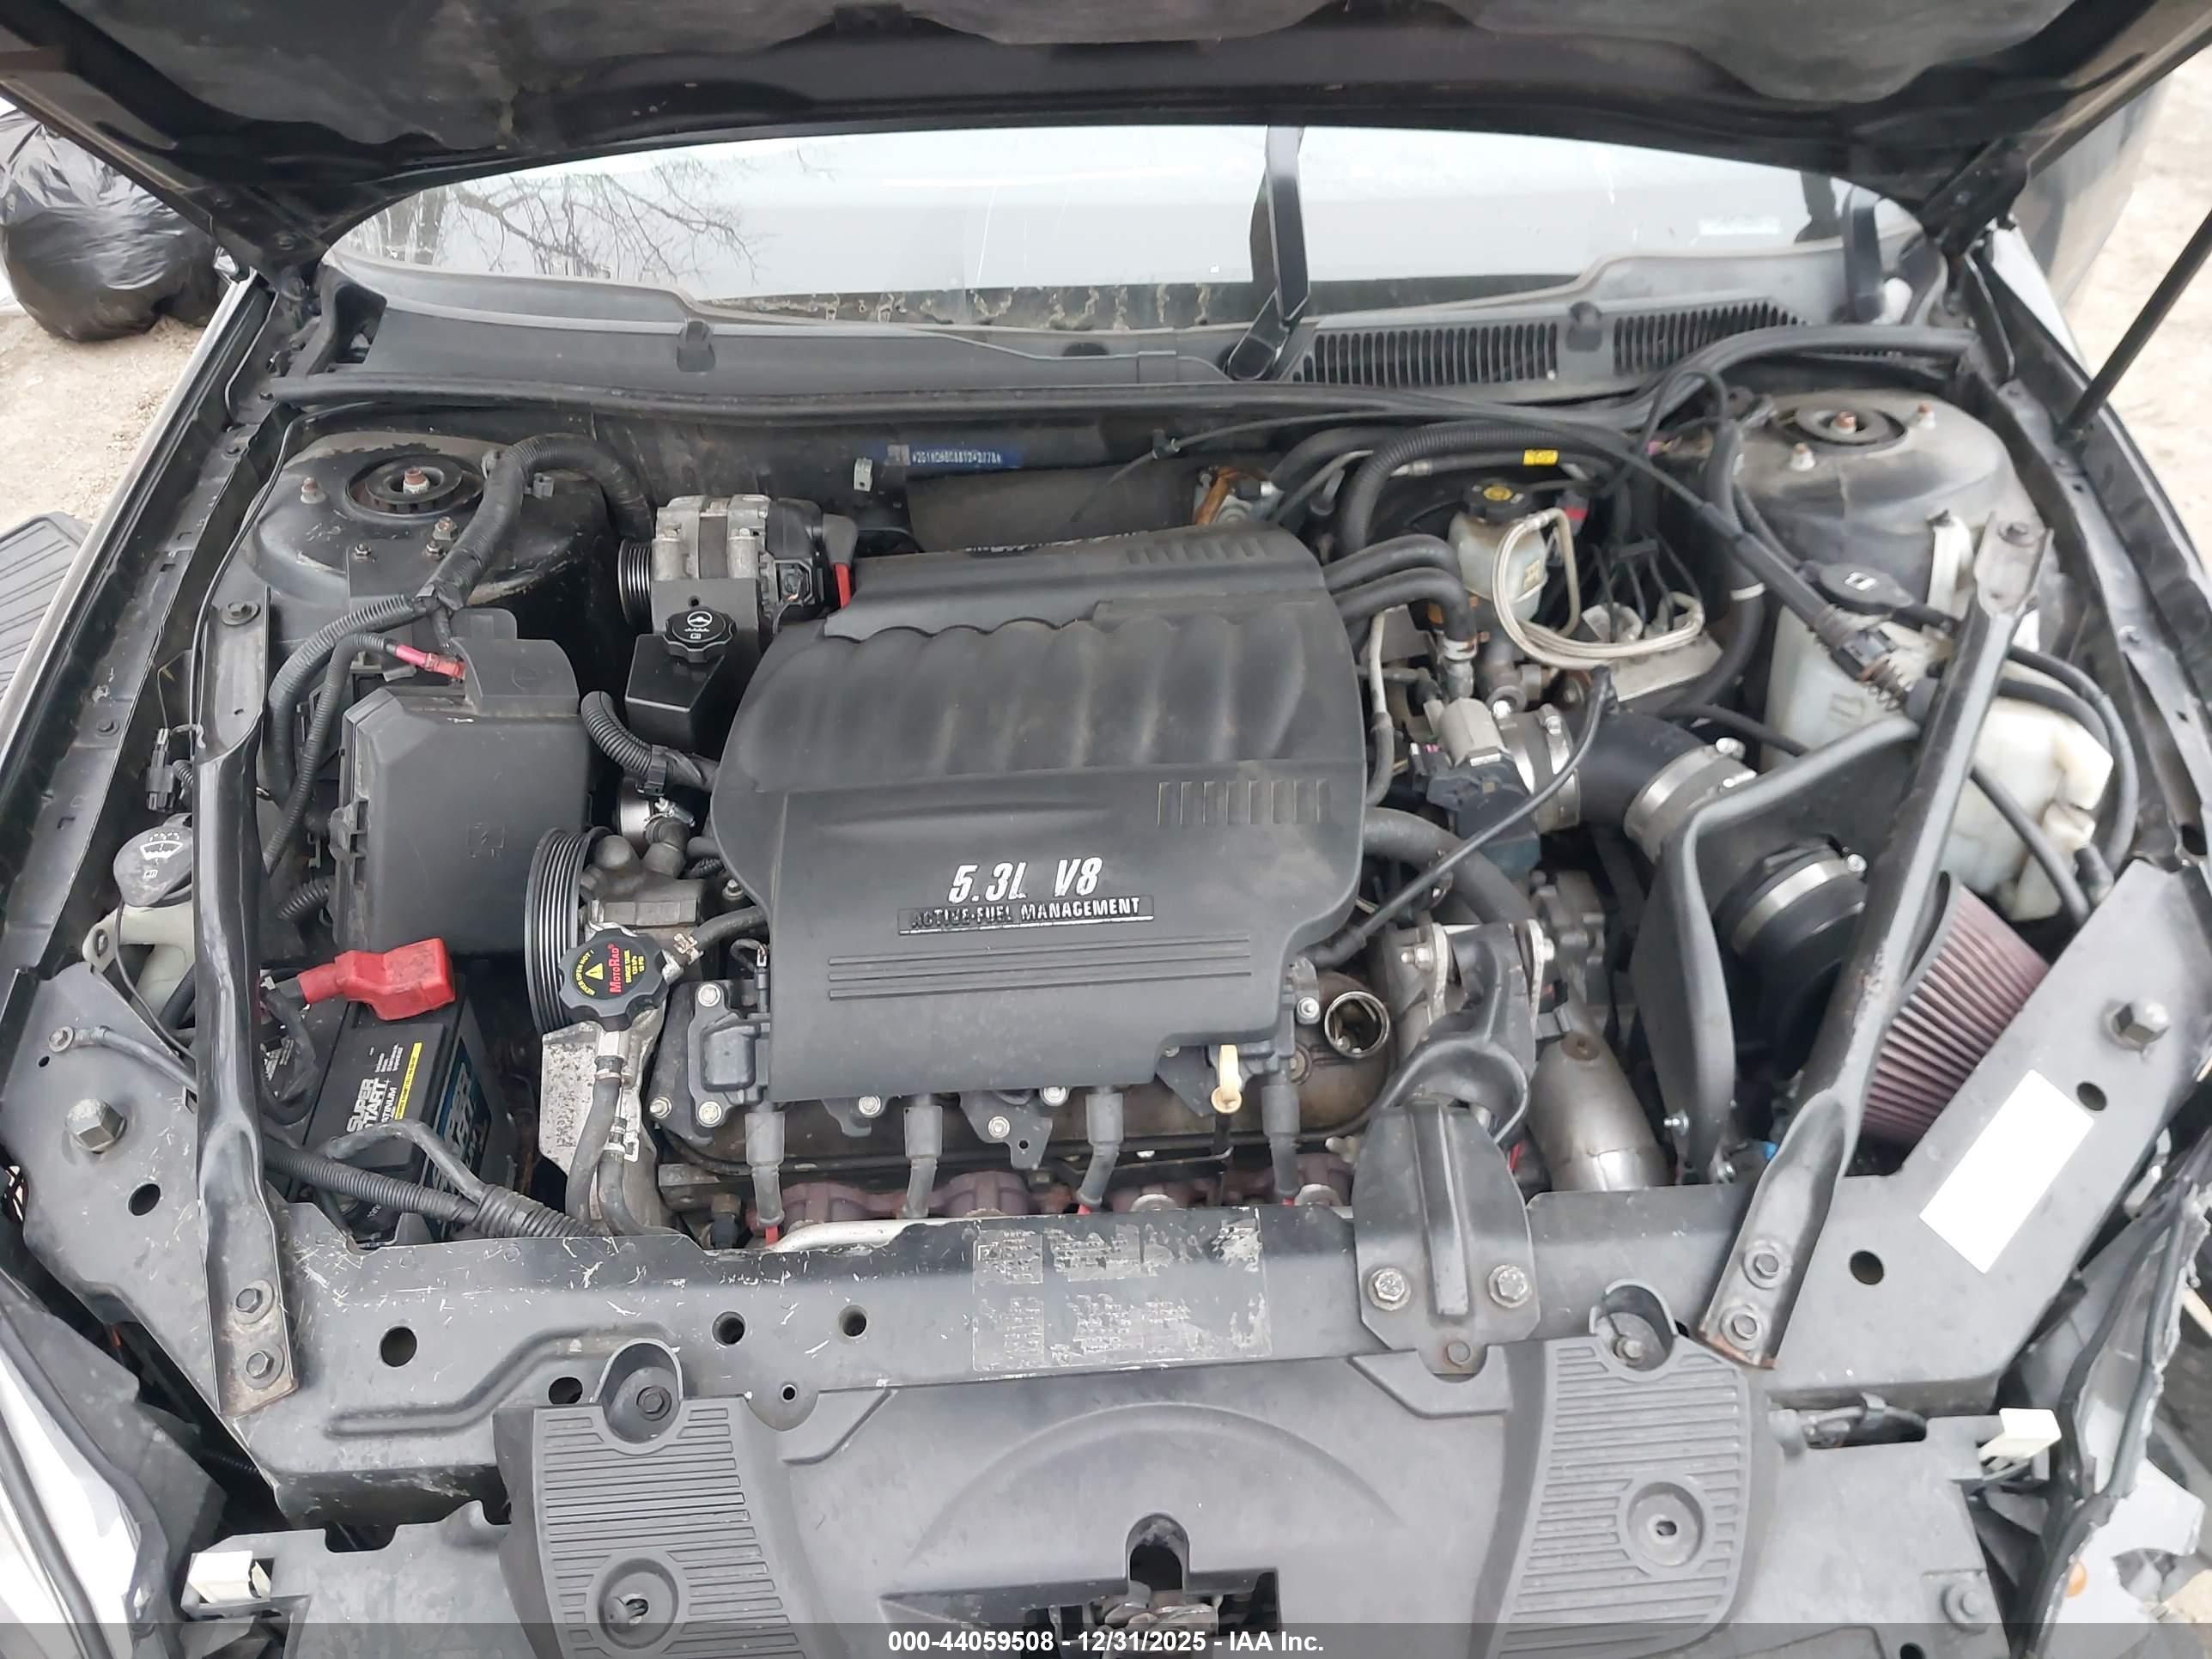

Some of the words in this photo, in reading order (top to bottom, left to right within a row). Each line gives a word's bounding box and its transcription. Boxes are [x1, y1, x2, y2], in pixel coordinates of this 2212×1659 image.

[948, 860, 1027, 904] 5.3L
[1054, 857, 1103, 897] V8
[1020, 897, 1140, 921] MANAGEMENT
[575, 963, 584, 981] OPEN
[346, 1079, 374, 1133] SUPER
[380, 1086, 398, 1123] ATINUM
